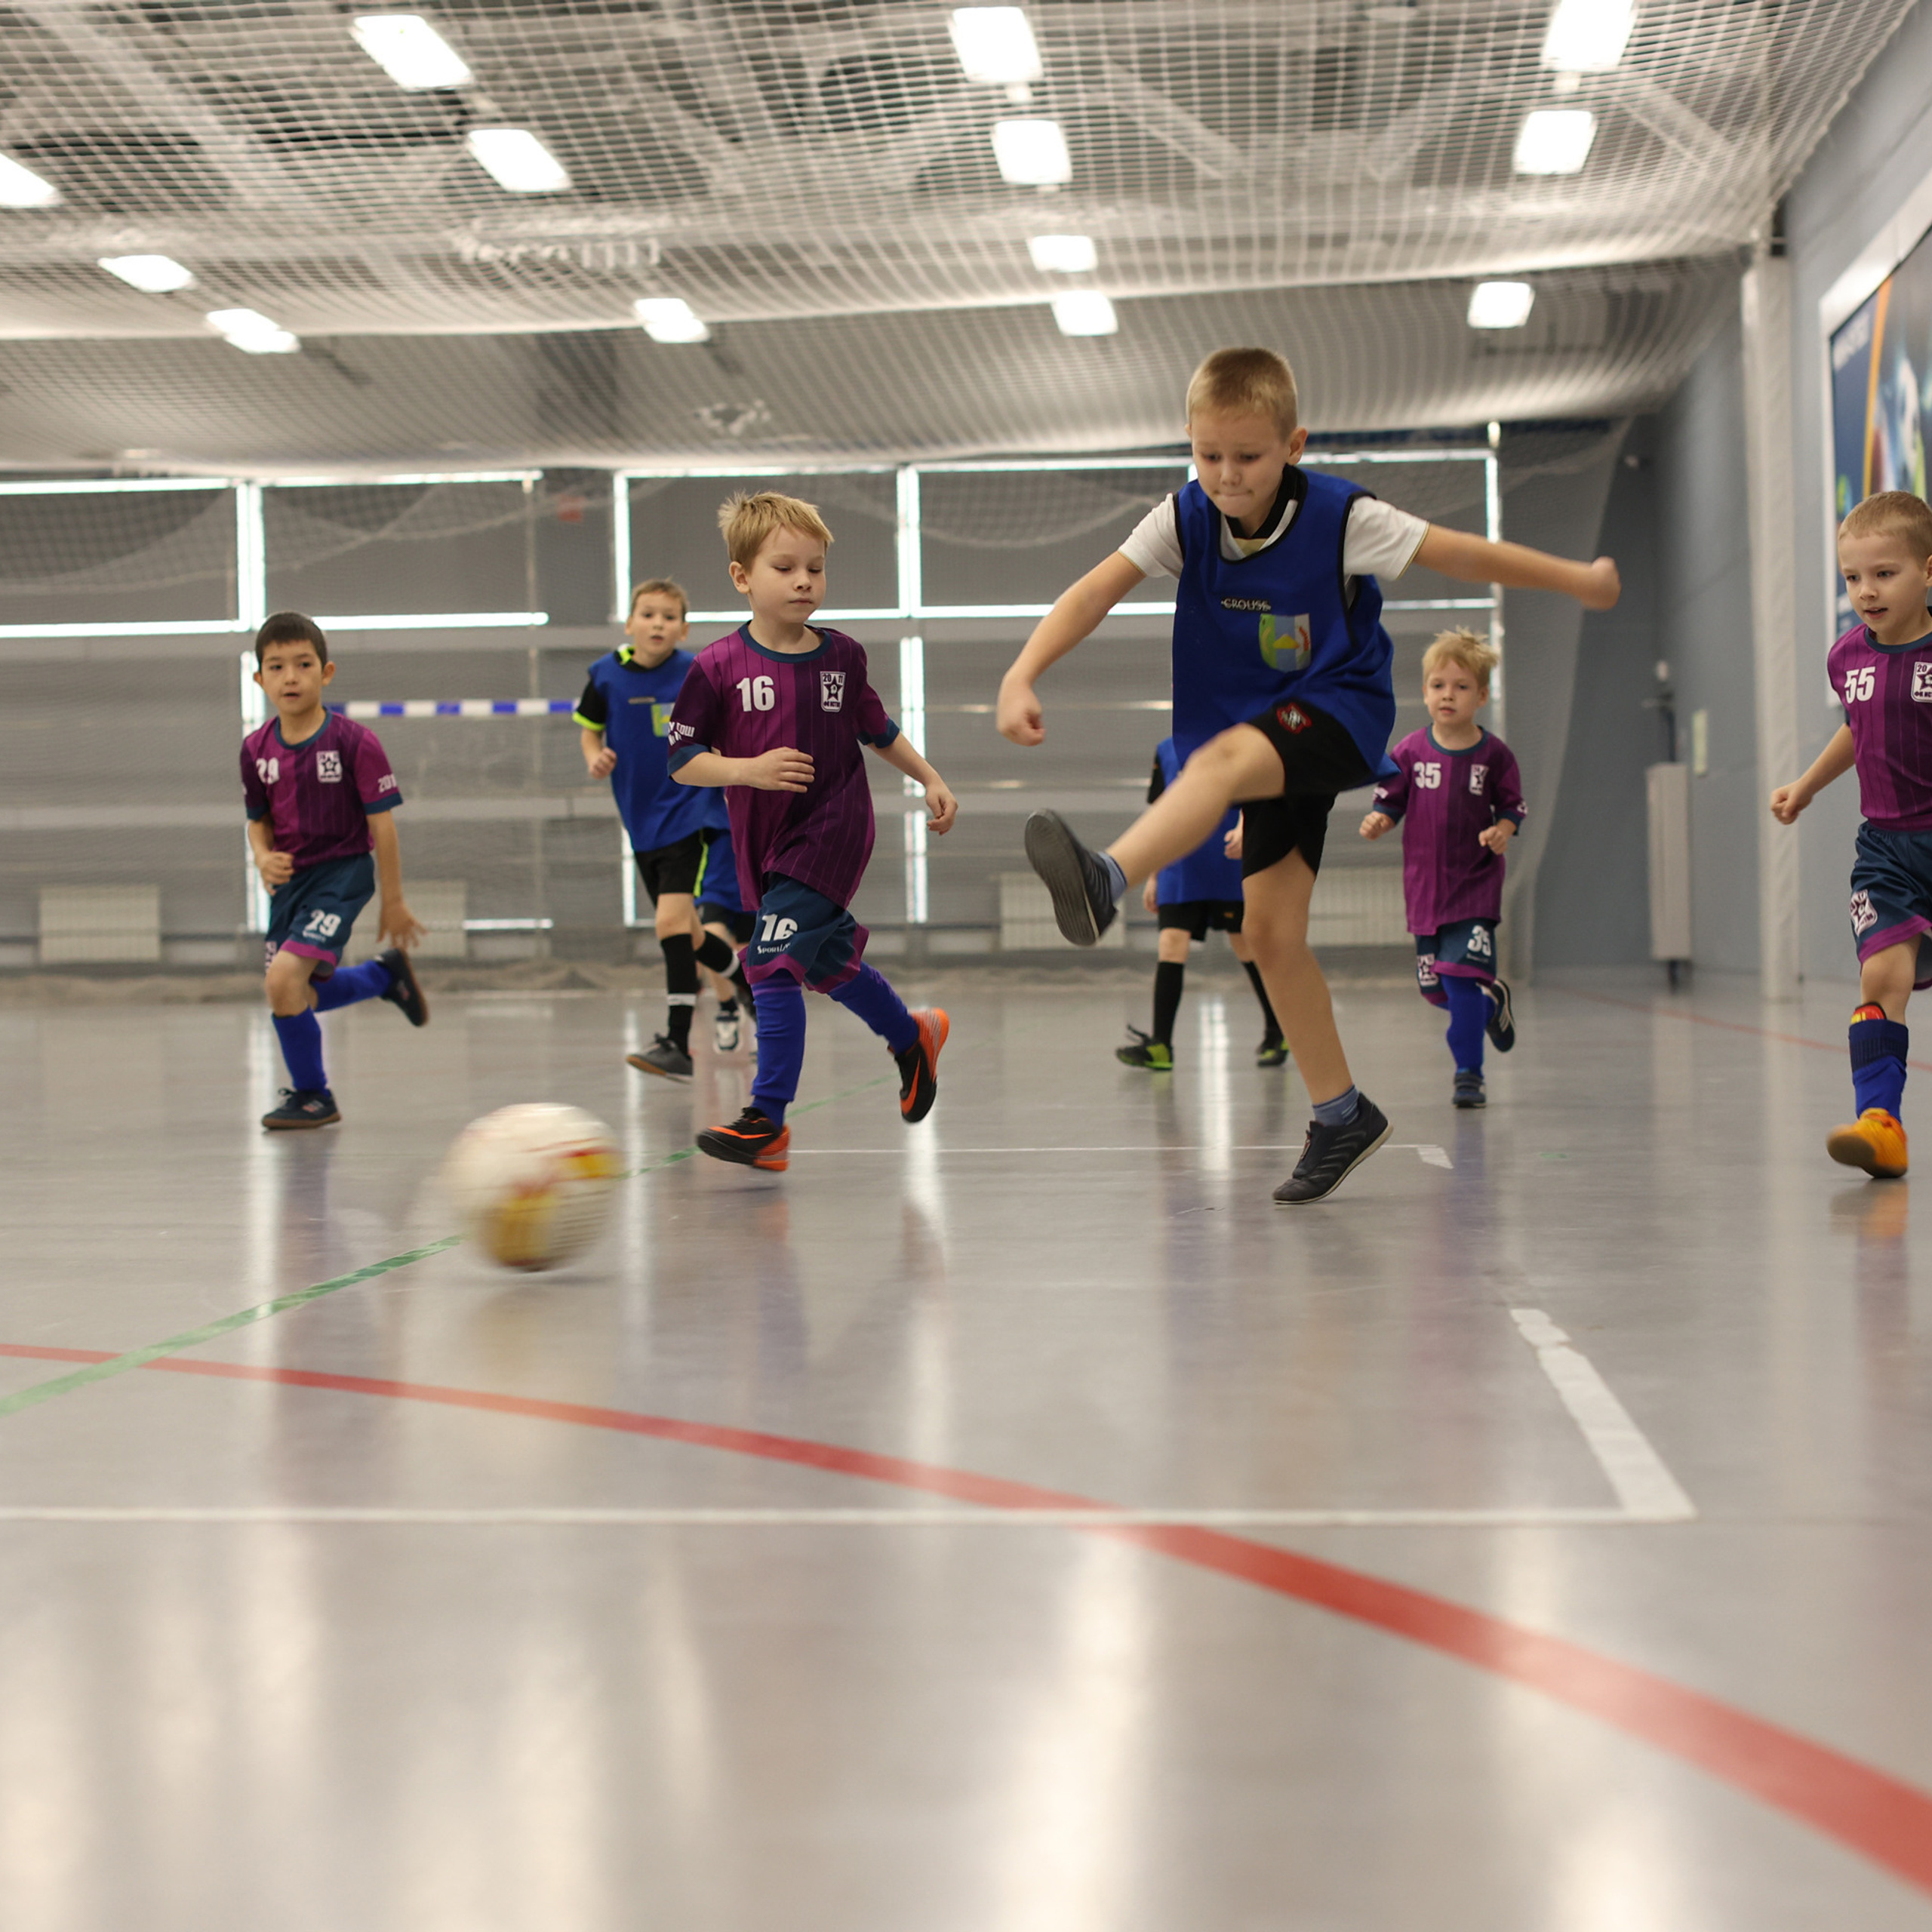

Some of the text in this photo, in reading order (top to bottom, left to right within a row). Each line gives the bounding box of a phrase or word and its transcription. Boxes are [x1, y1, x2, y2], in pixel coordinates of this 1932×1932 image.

[823, 674, 832, 682] 20
[1844, 666, 1876, 704] 55
[736, 675, 775, 712] 16
[256, 757, 280, 785] 29
[1413, 761, 1441, 789] 35
[304, 909, 341, 937] 29
[761, 913, 798, 942] 16
[1467, 924, 1491, 956] 35
